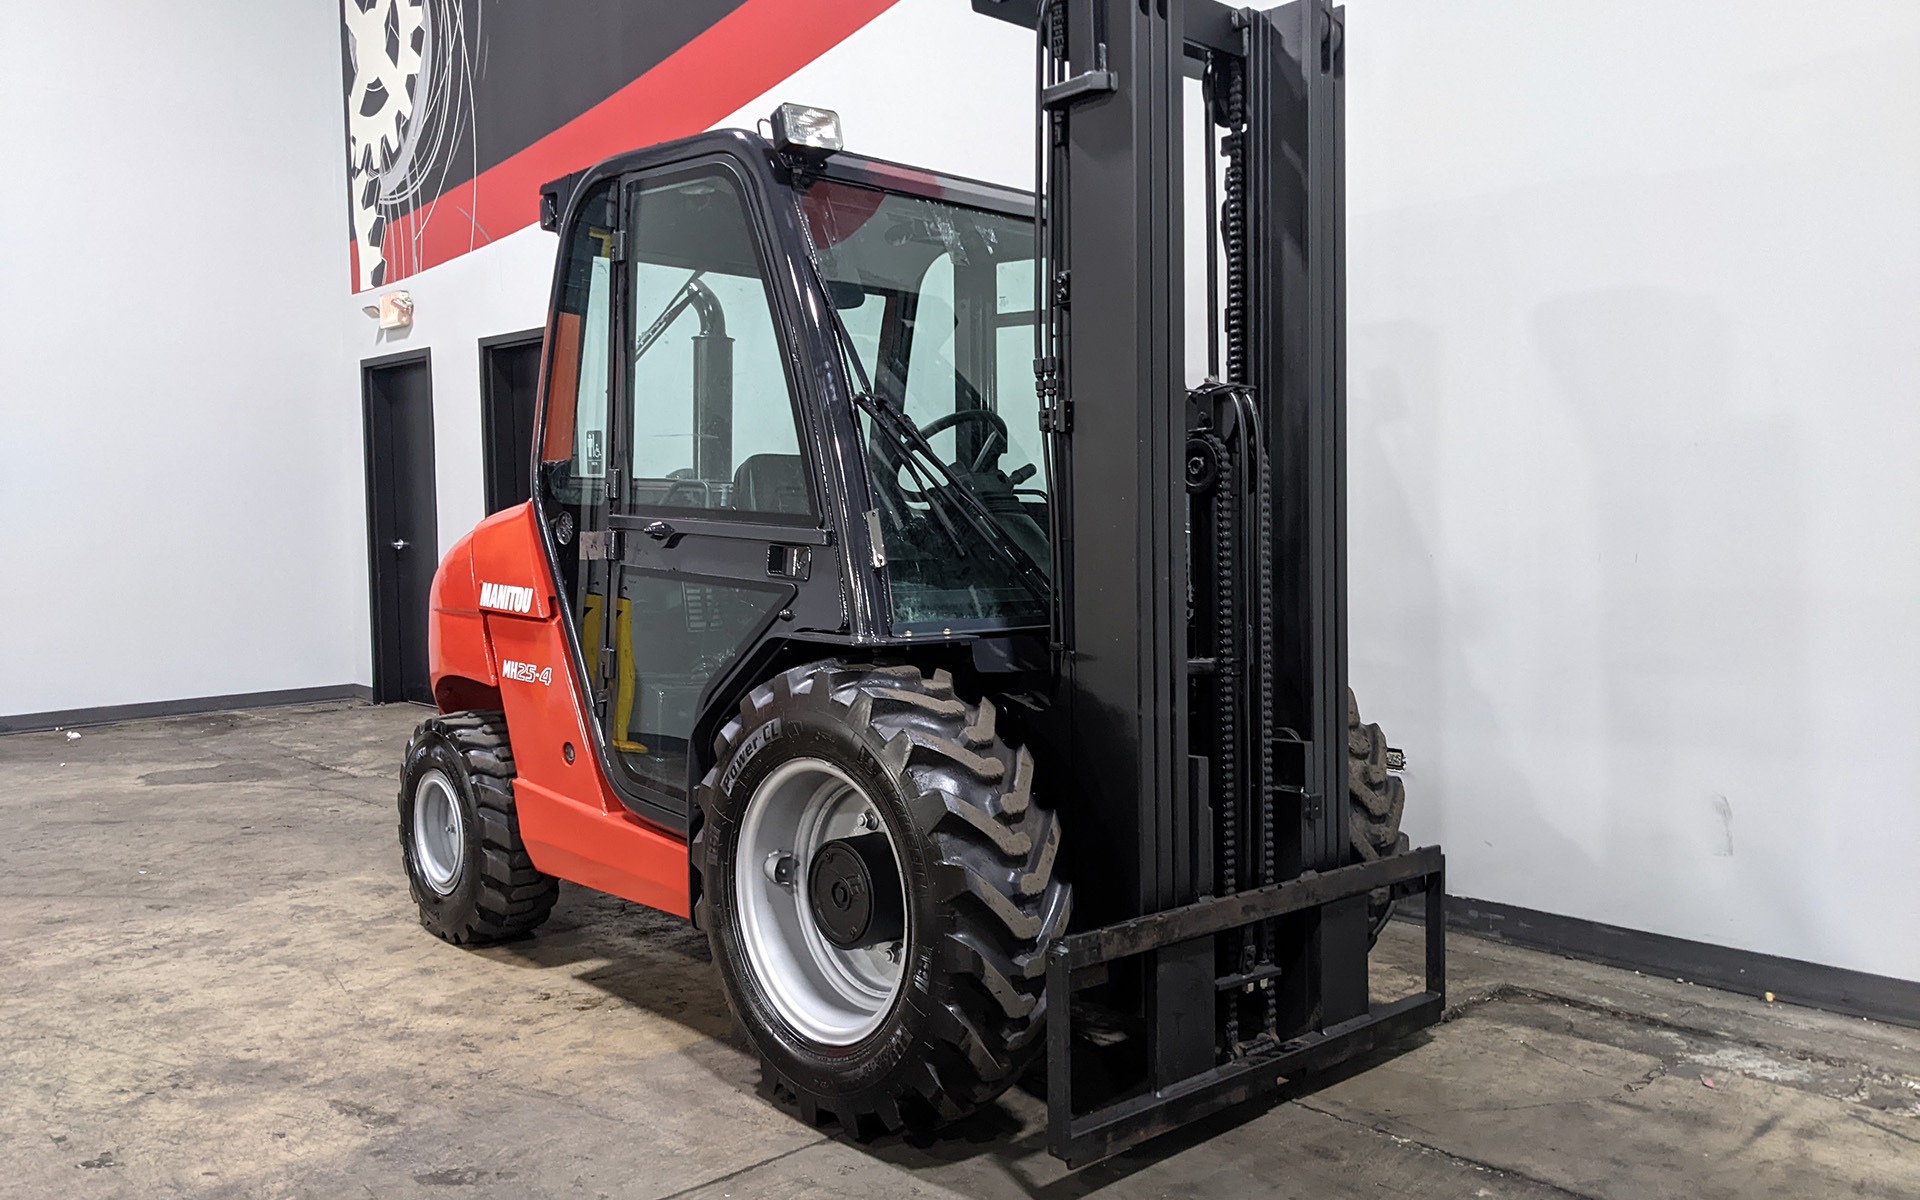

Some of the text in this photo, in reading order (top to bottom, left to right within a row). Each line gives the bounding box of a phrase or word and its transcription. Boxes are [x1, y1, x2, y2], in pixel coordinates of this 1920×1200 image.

[479, 582, 534, 614] MANITOU
[722, 735, 759, 792] Power
[763, 722, 779, 741] CL
